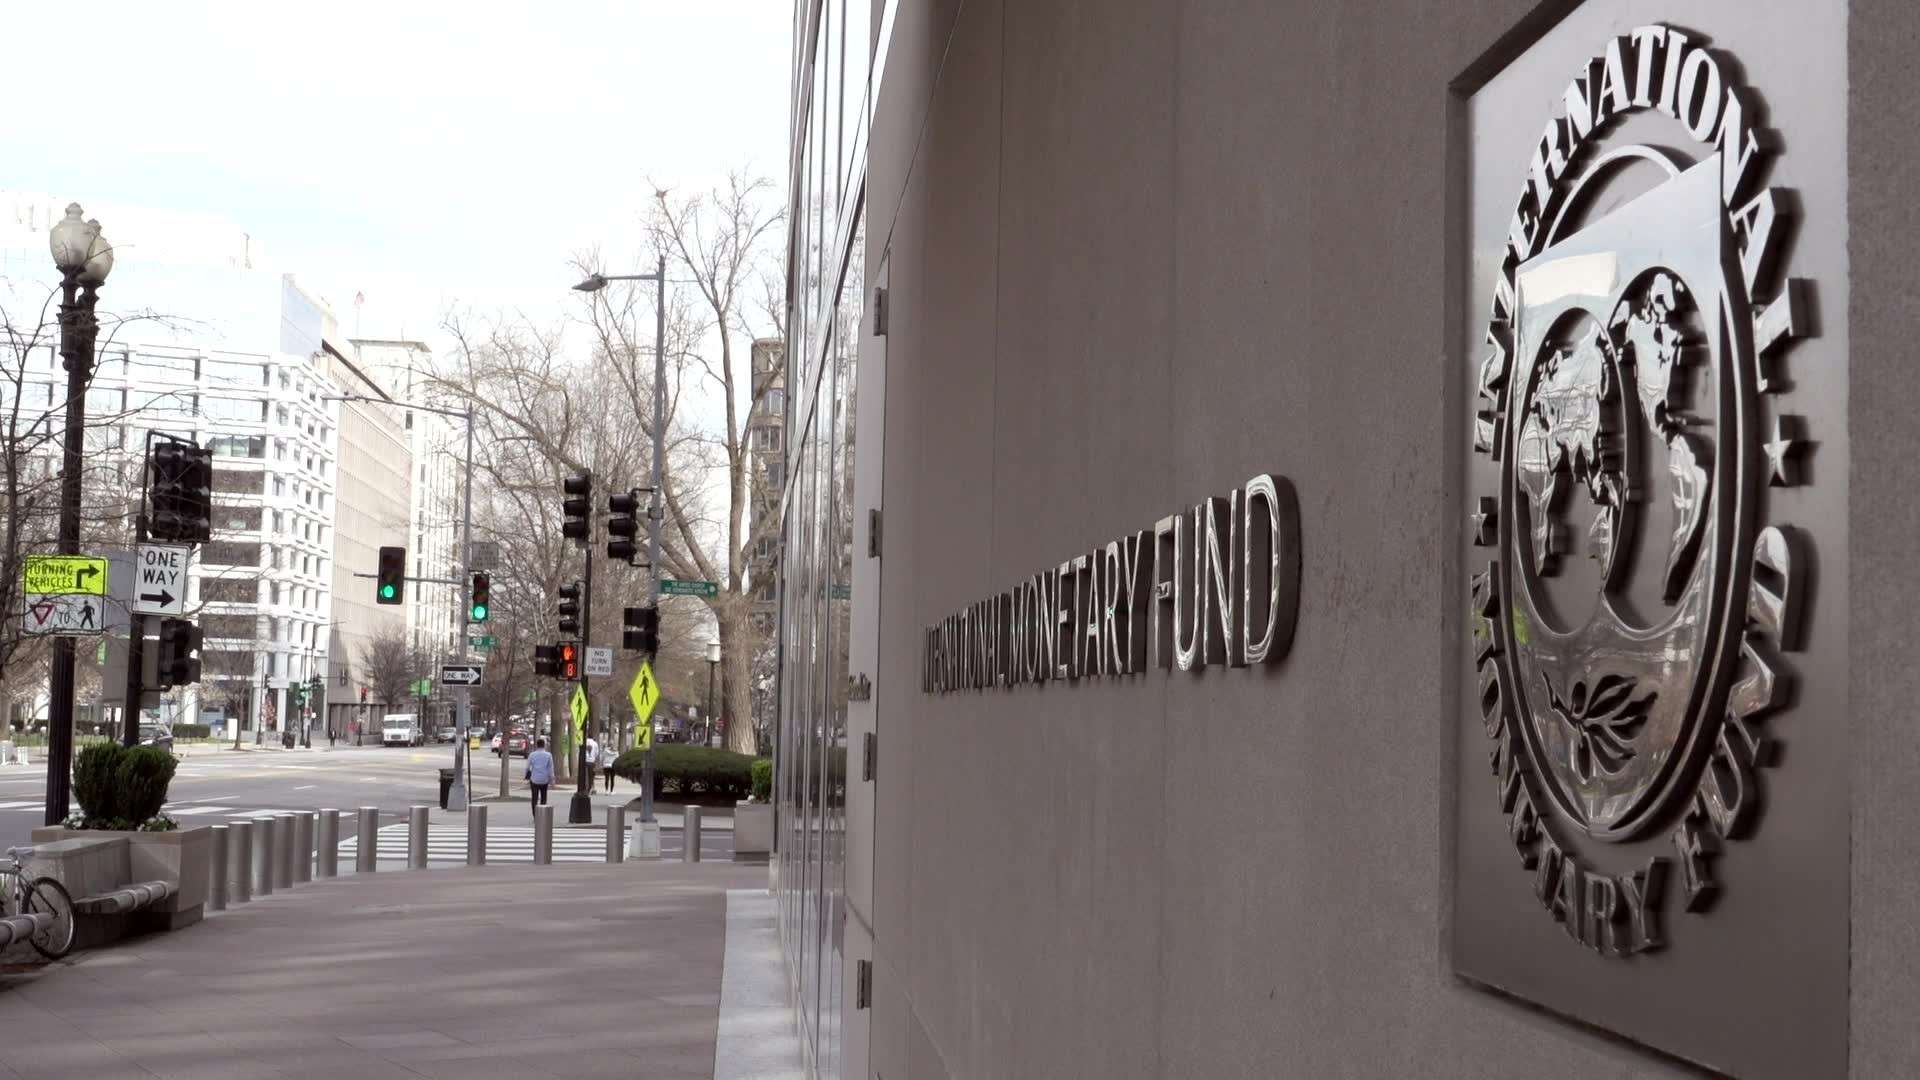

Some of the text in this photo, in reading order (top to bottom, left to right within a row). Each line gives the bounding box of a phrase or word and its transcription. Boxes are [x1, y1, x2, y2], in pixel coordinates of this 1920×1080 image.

[145, 551, 180, 568] ONE
[28, 563, 73, 576] TURNING
[28, 576, 73, 588] VEHICLES
[143, 568, 179, 586] WAY
[1008, 530, 1146, 685] MONETARY
[1154, 473, 1300, 671] FUND
[58, 611, 71, 625] TO
[461, 671, 474, 679] WAY
[587, 665, 610, 673] ON RED
